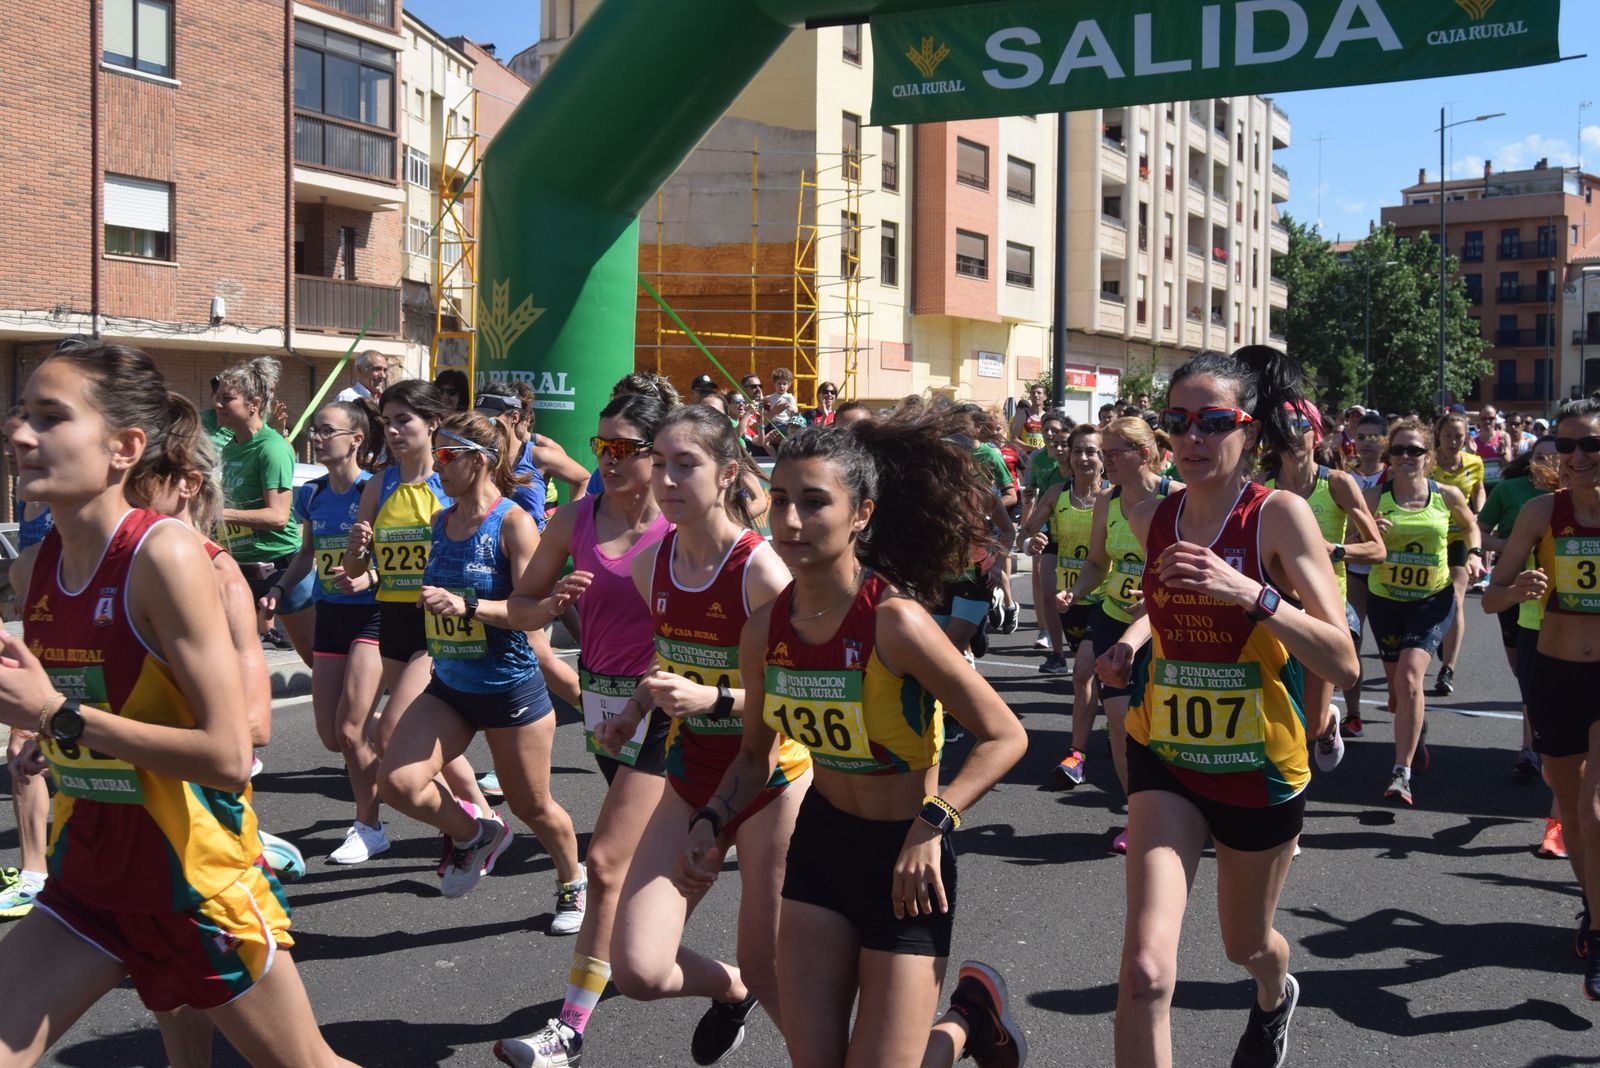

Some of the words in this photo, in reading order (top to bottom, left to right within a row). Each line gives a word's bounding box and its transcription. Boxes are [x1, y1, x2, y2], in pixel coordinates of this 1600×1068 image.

[1426, 29, 1467, 45] CAJA
[1468, 20, 1528, 40] RURAL
[982, 0, 1404, 90] SALIDA
[892, 83, 920, 97] CAJA
[921, 79, 965, 94] RURAL
[539, 401, 567, 409] ZAMORA
[381, 545, 427, 571] 223
[1388, 565, 1430, 587] 190
[1173, 594, 1196, 605] CAJA
[1173, 614, 1213, 628] VINO
[674, 628, 692, 637] CAJA
[694, 630, 719, 641] RURAL
[1186, 629, 1233, 643] TORO
[44, 647, 65, 661] CAJA
[66, 648, 105, 663] RURAL
[458, 646, 485, 654] RURAL
[671, 644, 728, 660] FUNDACION
[672, 653, 695, 664] CAJA
[696, 657, 730, 668] RURAL
[1180, 665, 1246, 679] FUNDACION
[787, 674, 846, 688] FUNDACION
[1180, 676, 1205, 687] CAJA
[1208, 678, 1247, 688] RURAL
[788, 685, 808, 698] CAJA
[810, 687, 846, 699] RURAL
[1163, 693, 1246, 739] 107
[773, 704, 852, 751] 136
[1181, 751, 1211, 765] CAJA
[1213, 752, 1258, 764] RURAL
[61, 775, 90, 790] CAJA
[90, 778, 136, 792] RURAL
